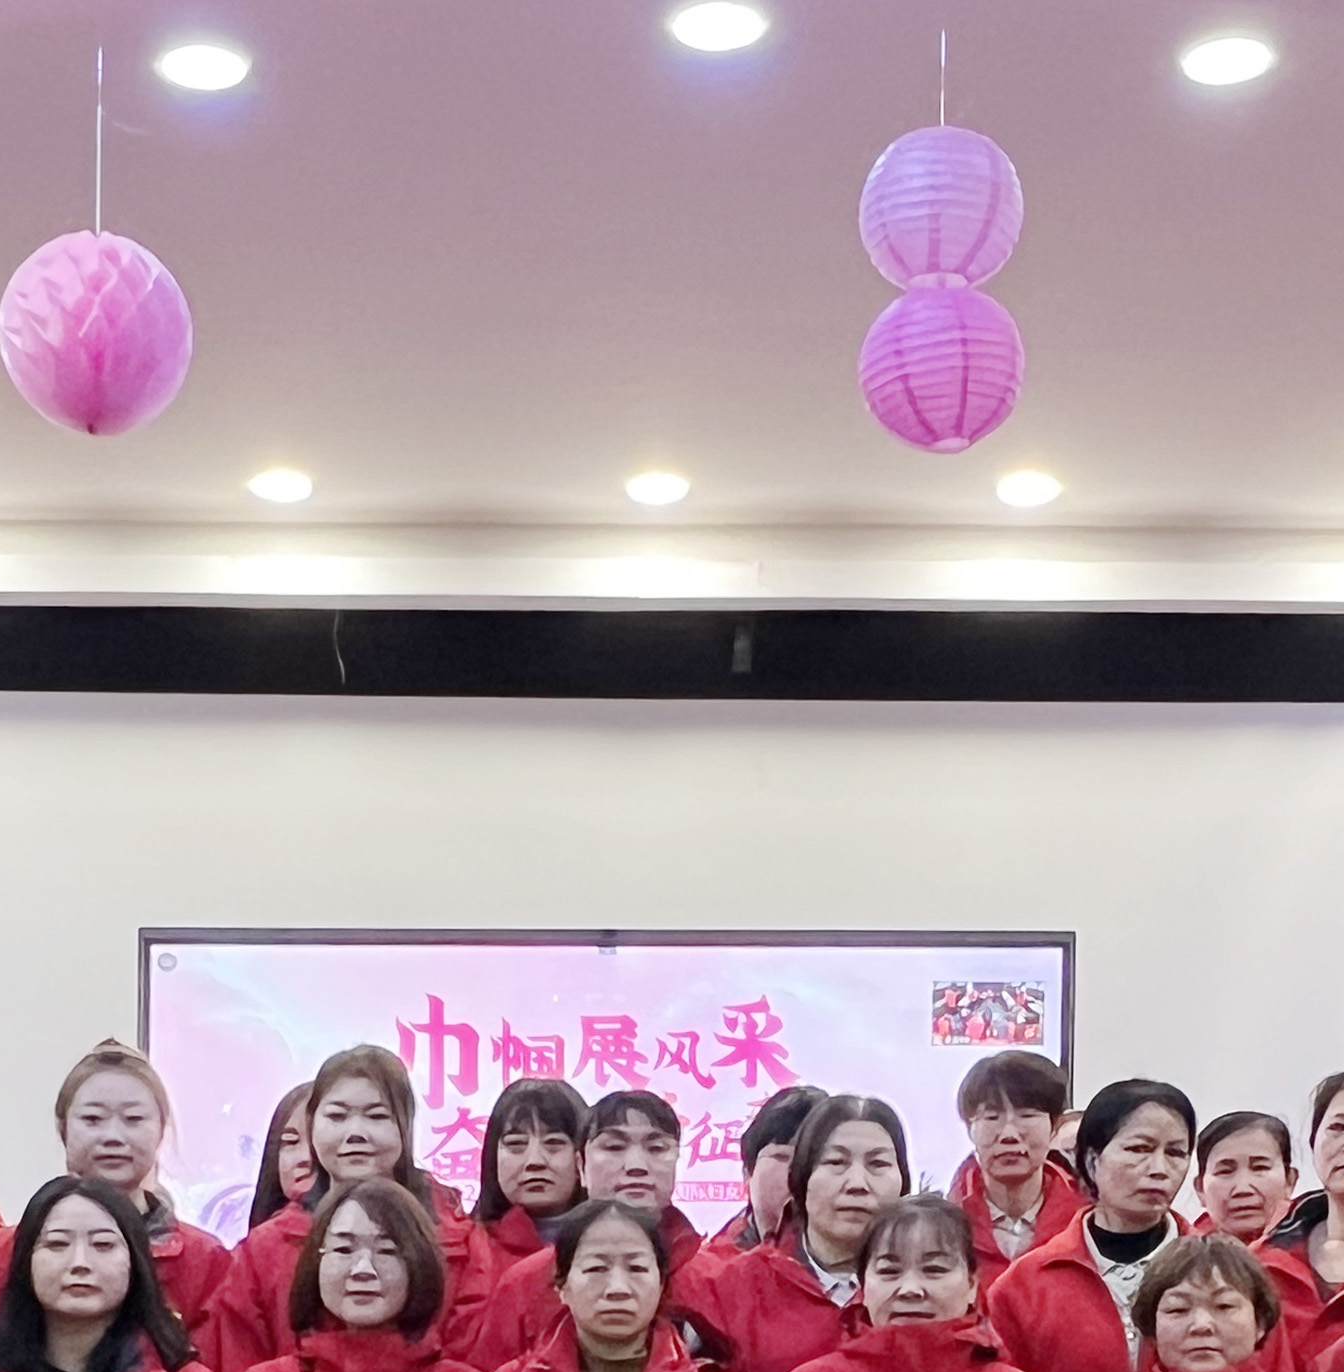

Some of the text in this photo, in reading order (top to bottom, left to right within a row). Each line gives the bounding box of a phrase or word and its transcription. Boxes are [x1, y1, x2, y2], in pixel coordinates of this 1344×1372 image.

[396, 992, 802, 1110] 巾帼展风采
